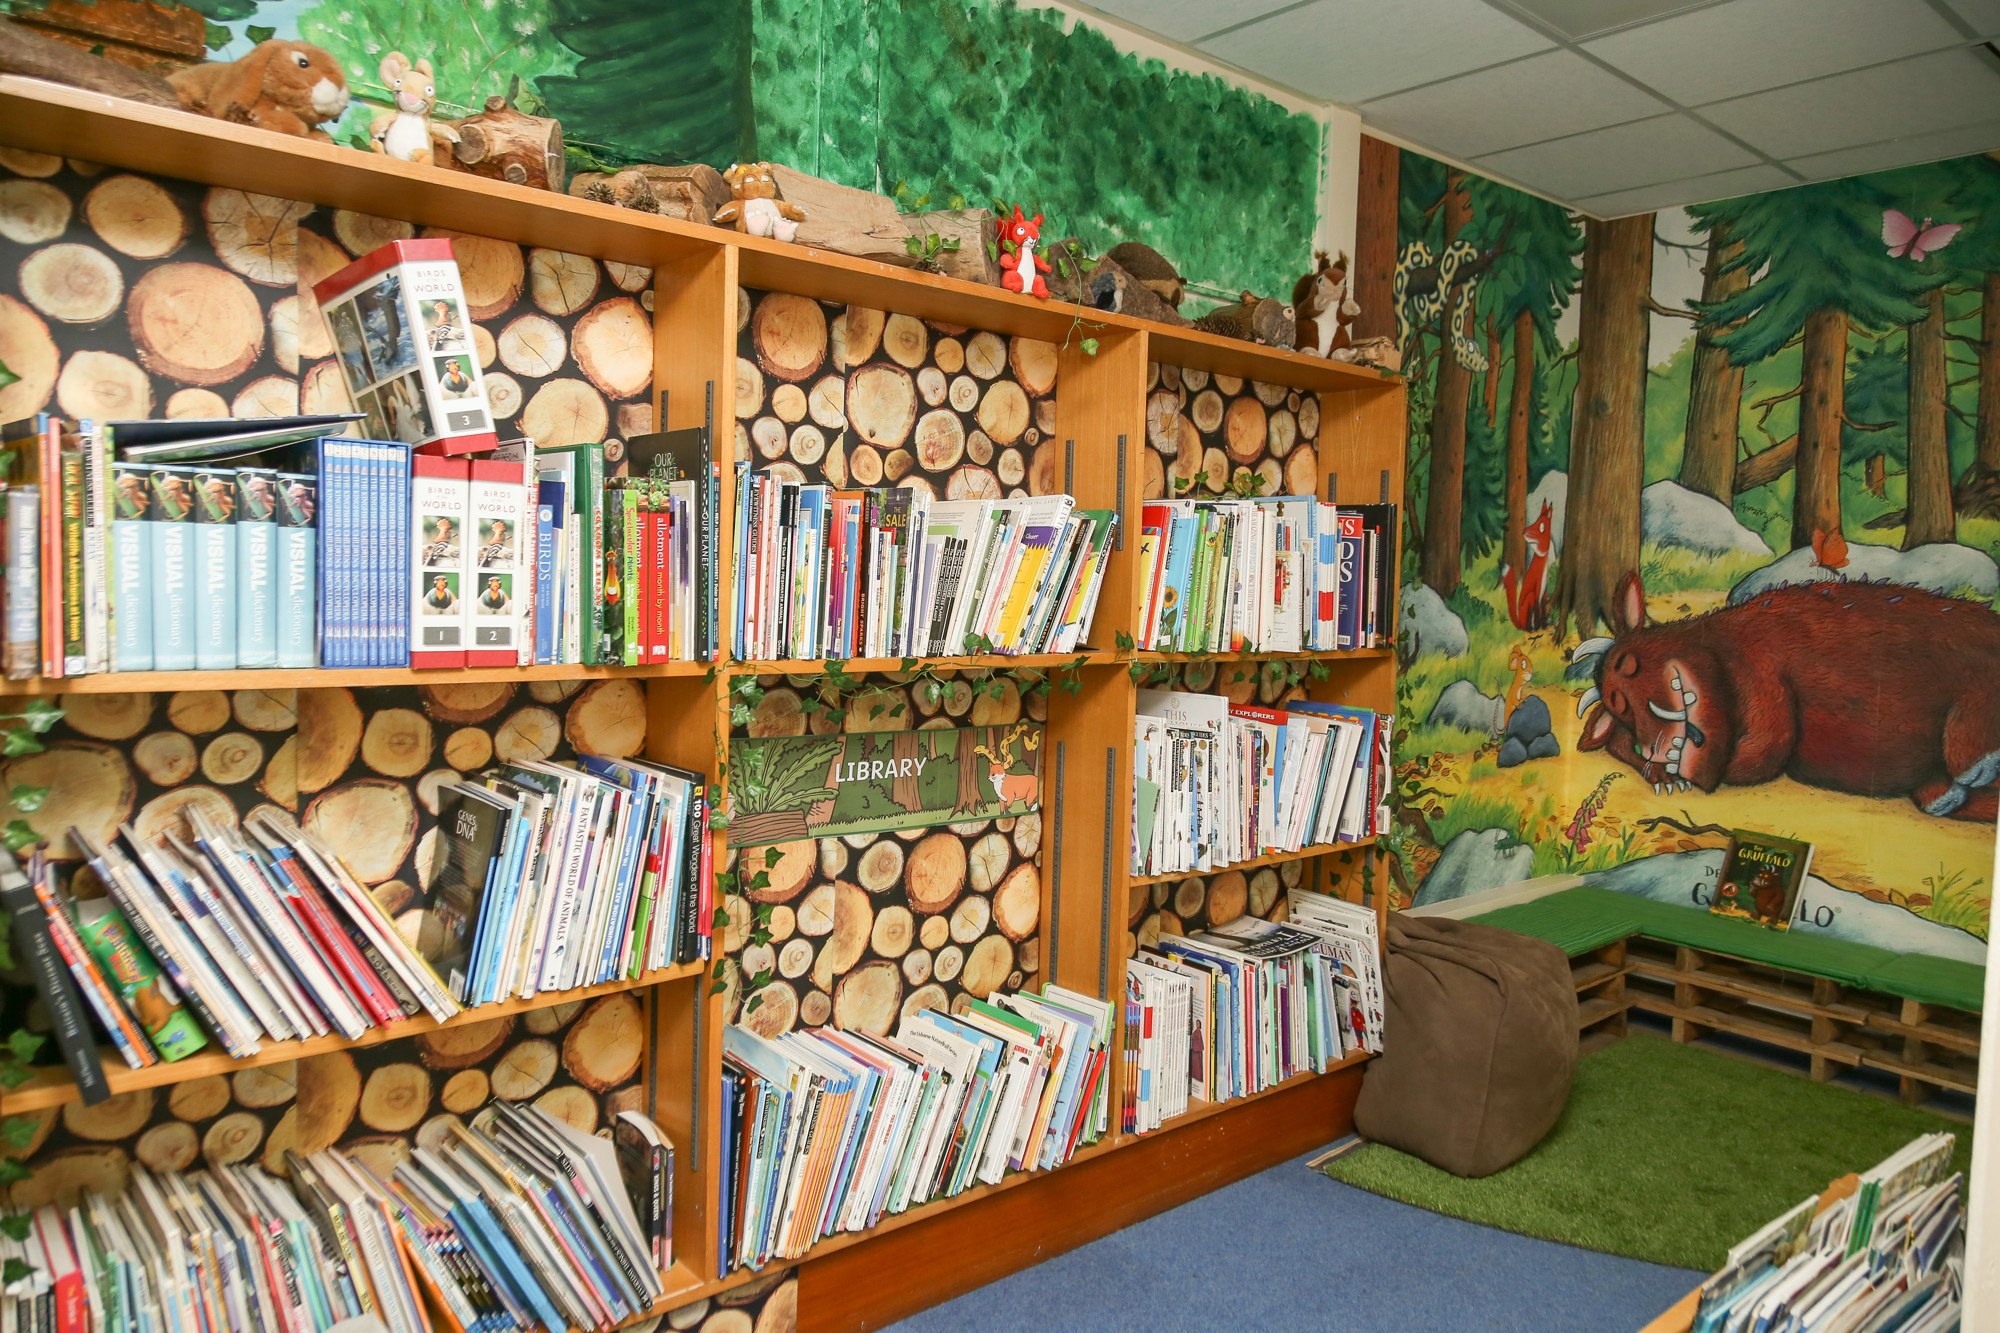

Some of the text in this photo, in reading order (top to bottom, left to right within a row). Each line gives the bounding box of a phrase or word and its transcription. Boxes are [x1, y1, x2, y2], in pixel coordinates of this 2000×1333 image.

[414, 283, 455, 292] WORLD
[417, 270, 447, 278] BIRDS
[462, 415, 470, 425] 3
[650, 467, 678, 480] PLANET
[655, 452, 672, 466] OUR
[325, 475, 333, 487] THE
[334, 476, 342, 488] THE
[370, 478, 378, 491] THE
[379, 479, 387, 491] THE
[397, 480, 405, 492] THE
[428, 487, 455, 495] BIRDS
[325, 489, 333, 529] KINGFISHER
[334, 490, 342, 530] KINGFISHER
[370, 492, 378, 532] KINGFISHER
[379, 493, 387, 533] KINGFISHER
[397, 494, 405, 533] KINGFISHER
[421, 501, 461, 510] WORLD
[478, 504, 516, 513] WORLD
[885, 514, 906, 527] SALE
[625, 507, 635, 555] Spectacular
[637, 517, 647, 568] allotment
[657, 518, 669, 569] allotment
[1250, 518, 1258, 541] AMAZING
[539, 533, 551, 581] BIRDS
[594, 510, 602, 606] SECRET WORLDS
[68, 523, 80, 641] Wildlife Adventures at Home
[121, 525, 140, 648] VISUAL dictionary
[164, 526, 183, 648] VISUAL dictionary
[207, 529, 224, 647] VISUAL dictionary
[250, 526, 266, 642] VISUAL dictionary
[289, 532, 306, 647] VISUAL dictionary
[325, 571, 333, 620] ENCYCLOPEDIA
[334, 571, 342, 620] ENCYCLOPEDIA
[370, 572, 378, 620] ENCYCLOPEDIA
[379, 572, 387, 621] ENCYCLOPEDIA
[397, 573, 405, 621] ENCYCLOPEDIA
[947, 579, 955, 597] FLOWERS
[952, 579, 960, 597] FLOWERS
[1203, 563, 1212, 601] Countryside
[1248, 574, 1256, 589] SPACE
[655, 599, 664, 607] by
[932, 577, 944, 622] FLOWERLESS PLANTS
[937, 577, 950, 622] FLOWERLESS PLANTS
[489, 631, 497, 640] 2
[1039, 600, 1058, 643] BRIGHT SPARKS
[1164, 709, 1187, 721] THIS
[1235, 708, 1275, 721] EXPLORERS
[836, 757, 927, 782] LIBRARY
[456, 820, 474, 842] DNA
[458, 809, 476, 825] GENES
[692, 820, 700, 843] Great
[625, 836, 633, 857] edition
[1738, 848, 1791, 868] GRUFFALO
[509, 856, 521, 886] COUNTDOWN
[556, 807, 590, 941] FANTASTIC WORLD OF ANIMALS
[690, 845, 699, 882] Wonders
[201, 890, 216, 908] FACTS
[211, 906, 222, 916] AT
[217, 913, 232, 931] YOUR
[227, 928, 252, 960] FINGERTIPS
[605, 882, 623, 949] FOUNDATION ATLAS
[688, 909, 696, 933] World
[1320, 944, 1353, 962] UMAN
[783, 1098, 791, 1119] Stories
[804, 1091, 823, 1154] EYEWITNESS GUIDES
[757, 1094, 770, 1158] EYEWITNESS GUIDES
[776, 1129, 786, 1153] Dragons
[354, 1202, 381, 1267] PICTURE REFERENCE
[559, 1157, 647, 1297] EVERYDAY THINGS WATTS
